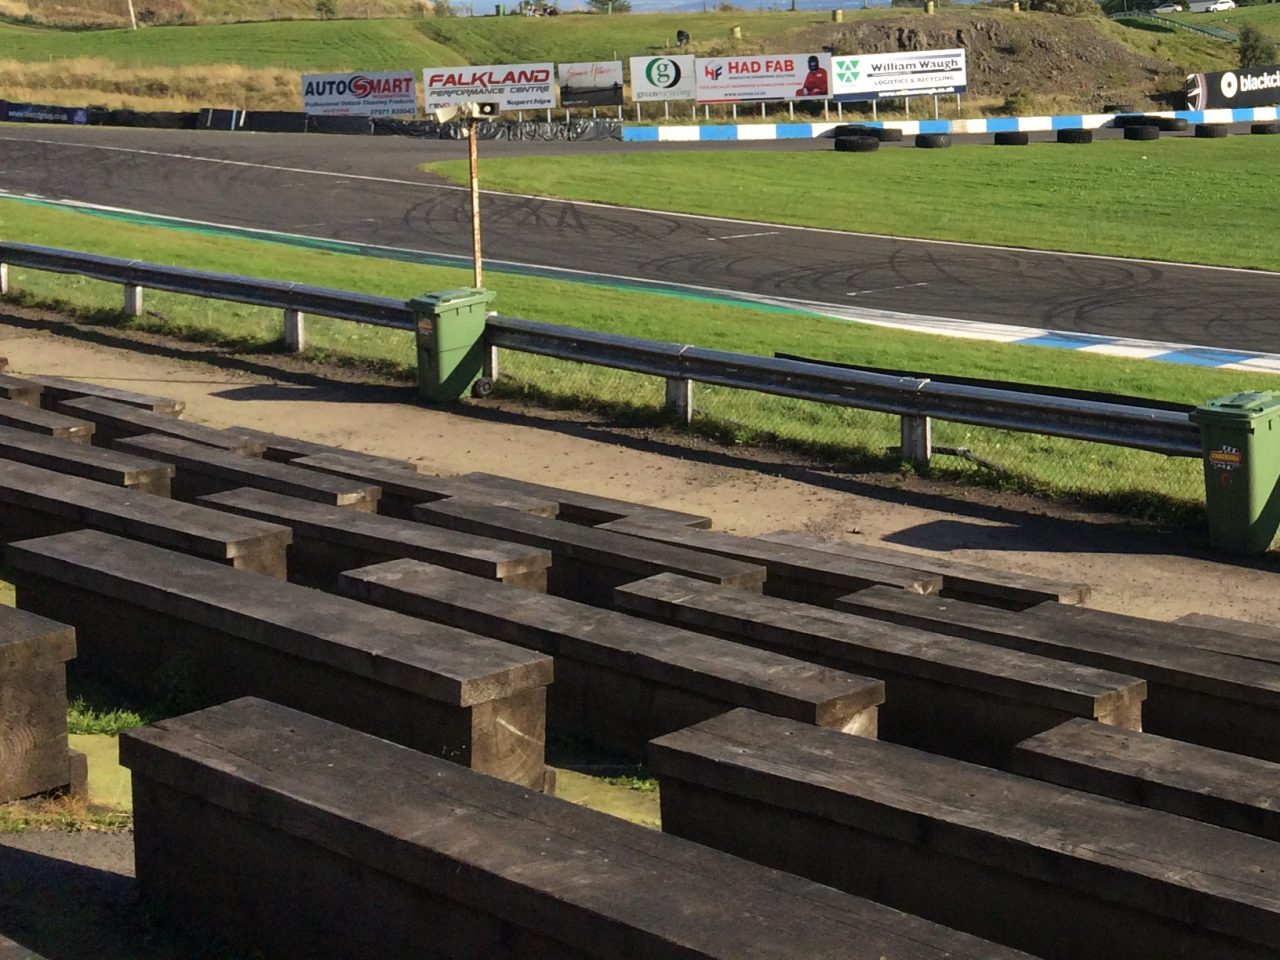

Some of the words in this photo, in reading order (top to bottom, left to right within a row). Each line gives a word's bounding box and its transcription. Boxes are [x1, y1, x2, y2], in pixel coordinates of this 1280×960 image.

[728, 60, 761, 74] HAD
[765, 59, 794, 73] FAB
[871, 61, 916, 72] William
[919, 58, 958, 71] Waugh
[428, 69, 550, 88] FALKLAND
[917, 75, 955, 83] RECYCLING
[429, 87, 505, 98] PERFORMANCE
[509, 85, 550, 95] CENTRE
[506, 98, 552, 106] Superchips
